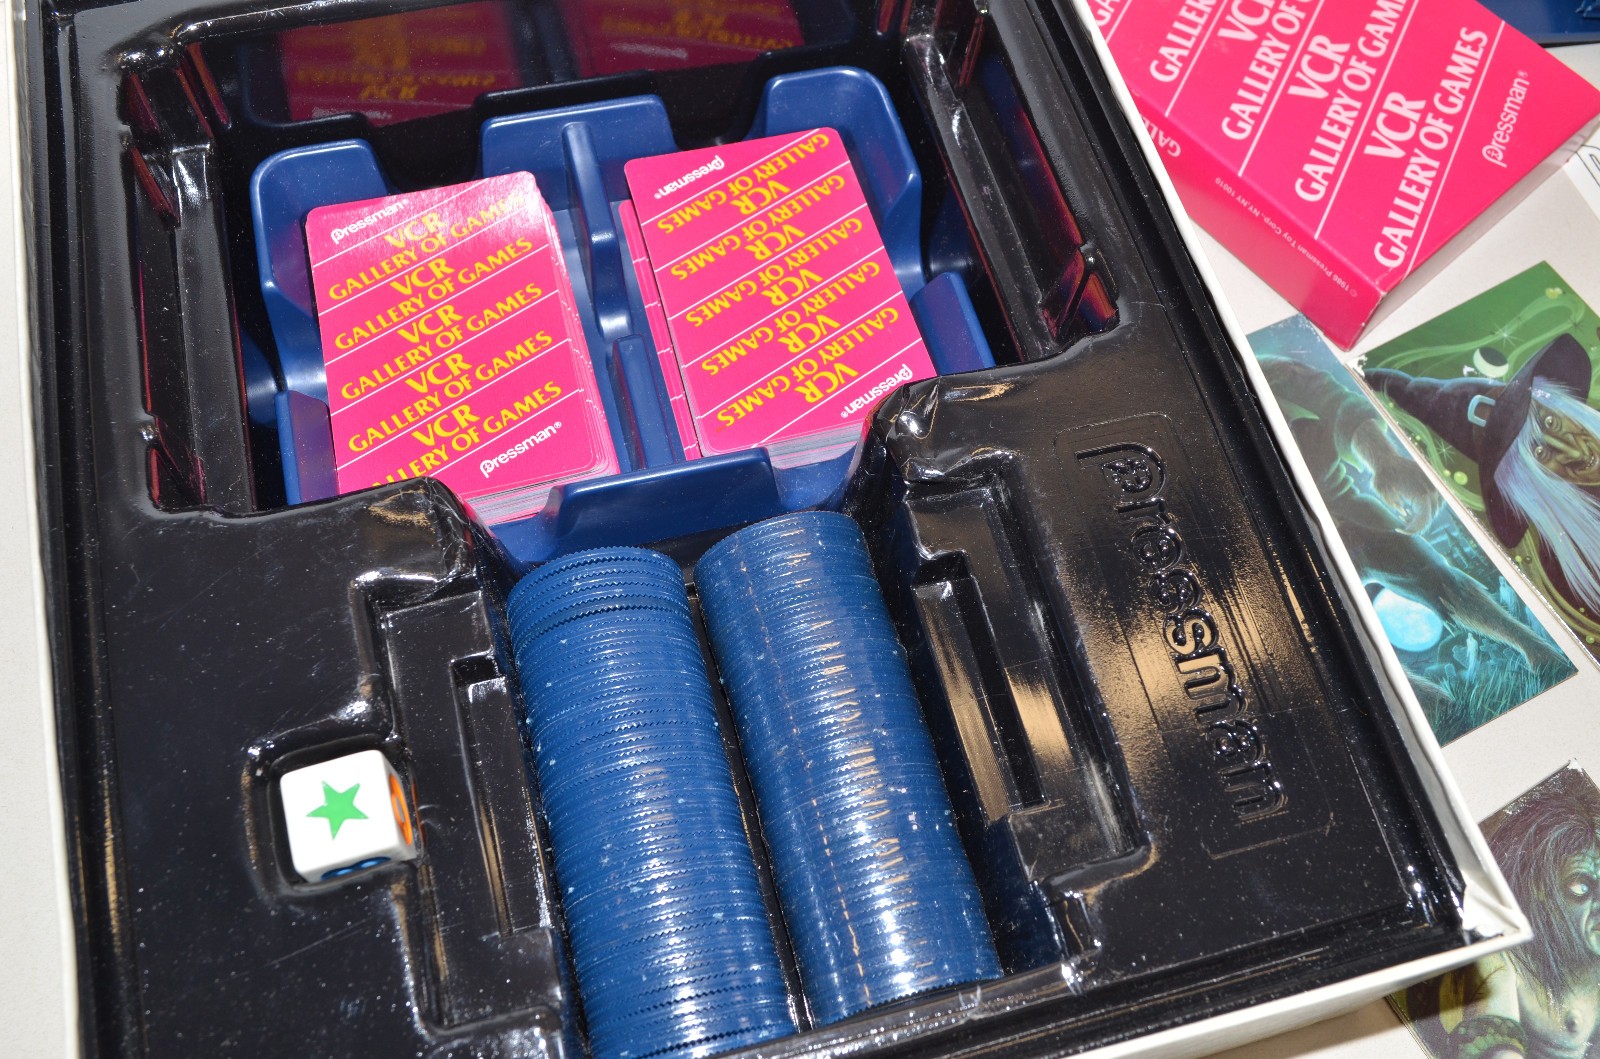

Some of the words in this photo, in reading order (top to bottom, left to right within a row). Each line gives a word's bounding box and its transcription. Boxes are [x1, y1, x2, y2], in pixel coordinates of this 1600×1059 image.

[1221, 32, 1291, 141] GALLERY
[1271, 0, 1306, 35] OF
[1287, 34, 1351, 99] VCR
[1433, 27, 1489, 115] GAMES
[1140, 114, 1181, 157] GALL
[1294, 89, 1363, 202] GALLERY
[1342, 54, 1377, 92] OF
[1363, 91, 1427, 159] VCR
[1418, 112, 1455, 151] OF
[752, 133, 830, 182] GALLERY
[727, 175, 753, 197] OF
[730, 179, 791, 215] VCR
[767, 174, 845, 227] GALLERY
[1215, 177, 1236, 197] 10010
[1373, 147, 1441, 269] GALLERY
[384, 211, 447, 249] VCR
[656, 189, 727, 235] GAMES
[741, 219, 768, 241] OF
[328, 246, 418, 300] GALLERY
[420, 232, 448, 253] OF
[450, 192, 525, 239] GAMES
[670, 234, 741, 281] GAMES
[745, 223, 806, 261] VCR
[784, 217, 864, 271] GALLERY
[1282, 232, 1297, 248] Toy
[1297, 244, 1333, 277] Pressman
[335, 293, 425, 350] GALLERY
[427, 278, 456, 300] OF
[457, 236, 533, 284] GAMES
[389, 258, 455, 295] VCR
[757, 264, 784, 287] OF
[761, 268, 823, 306] VCR
[801, 261, 880, 317] GALLERY
[1332, 274, 1350, 292] 1986
[397, 304, 463, 343] VCR
[685, 280, 757, 327] GAMES
[773, 310, 801, 334] OF
[341, 341, 433, 400] GALLERY
[435, 324, 464, 348] OF
[466, 283, 543, 331] GAMES
[701, 326, 774, 376] GAMES
[777, 314, 841, 354] VCR
[818, 307, 899, 365] GALLERY
[348, 391, 442, 452] GALLERY
[443, 374, 473, 398] OF
[474, 330, 553, 381] GAMES
[405, 353, 472, 394] VCR
[790, 358, 819, 382] OF
[794, 362, 859, 403] VCR
[451, 427, 481, 451] OF
[483, 381, 562, 433] GAMES
[717, 375, 791, 427] GAMES
[411, 404, 480, 446] VCR
